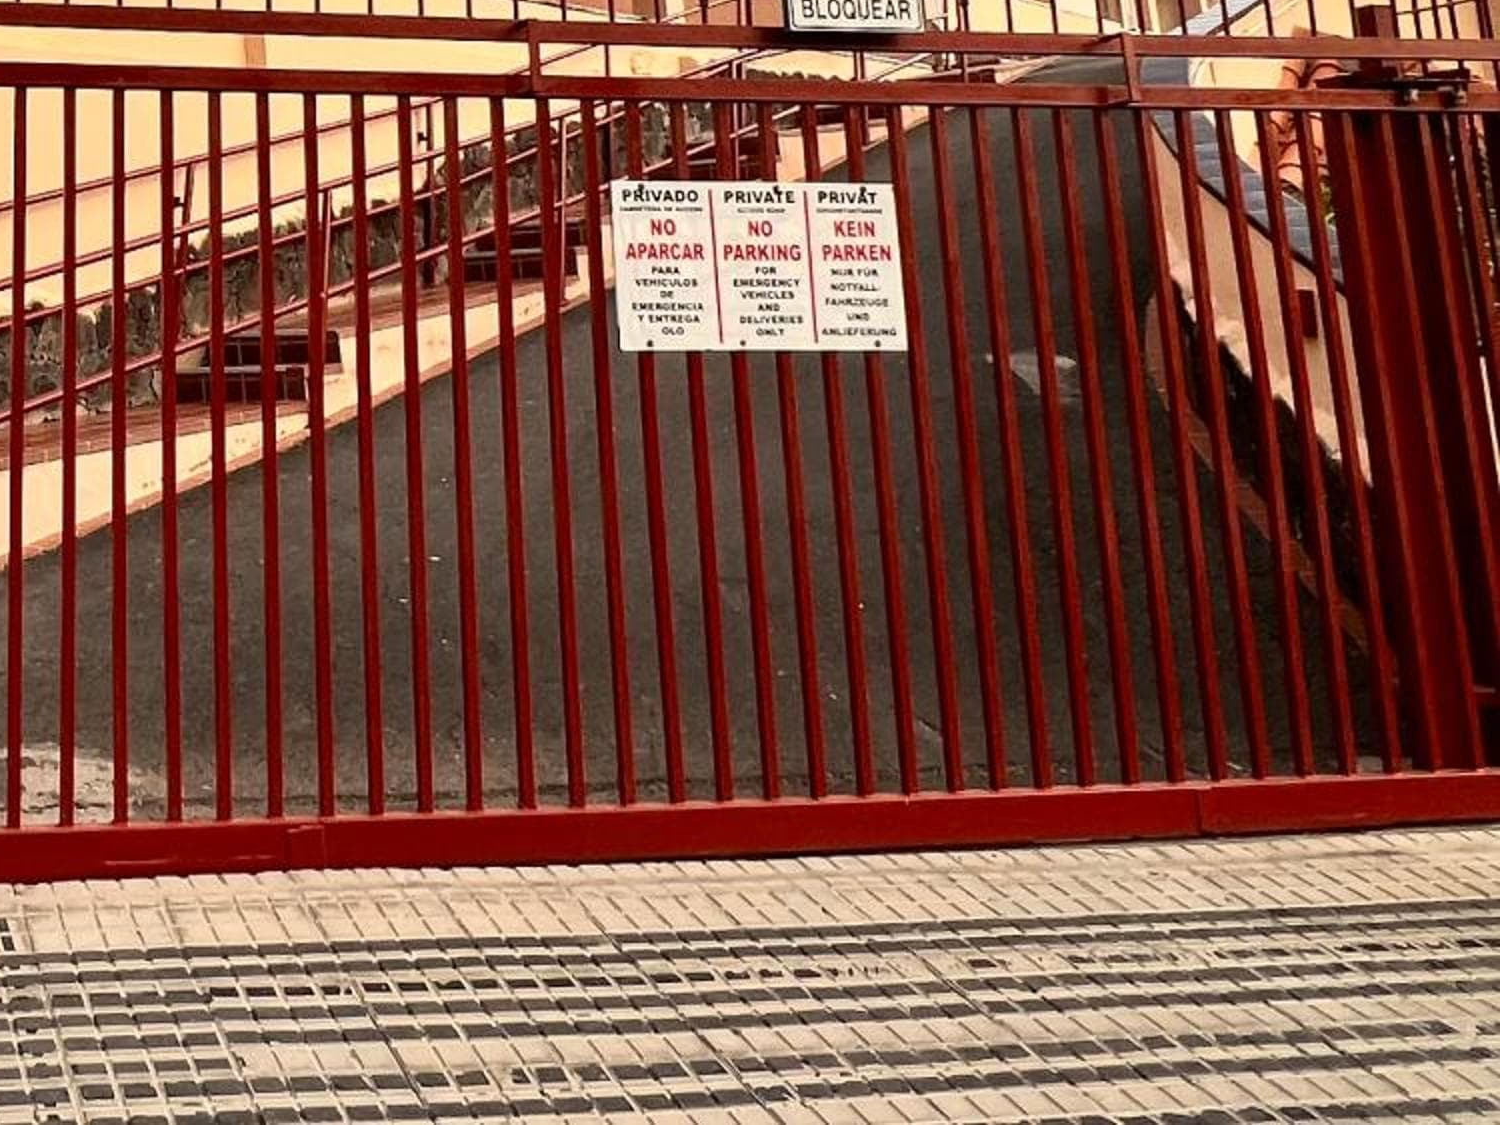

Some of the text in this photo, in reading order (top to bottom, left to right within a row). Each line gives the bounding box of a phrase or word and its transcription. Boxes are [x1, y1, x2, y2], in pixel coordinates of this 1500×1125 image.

[621, 189, 699, 202] PRIVADO
[724, 190, 796, 203] PRIVATE
[817, 190, 877, 204] PRIVAT
[650, 219, 676, 236] NO
[748, 220, 773, 237] NO
[833, 220, 876, 237] KEIN
[626, 243, 705, 261] APARCAR
[723, 244, 801, 262] PARKING
[822, 244, 892, 262] PARKEN
[651, 266, 680, 275] PARA
[755, 266, 777, 275] FOR
[831, 268, 854, 276] NUR
[635, 278, 698, 288] VEHICULOS
[733, 278, 800, 287] EMERGENCY
[660, 290, 674, 299] DE
[740, 290, 795, 299] VEHICLES
[632, 302, 704, 311] EMERGENCIA
[757, 302, 781, 312] AND
[825, 297, 889, 308] FAHRZEUGE
[649, 315, 700, 323] ENTREGA
[740, 315, 804, 324] DELIVERIES
[846, 312, 871, 321] UND
[756, 328, 785, 336] ONLY
[822, 327, 897, 336] ANLIEFERUNG
